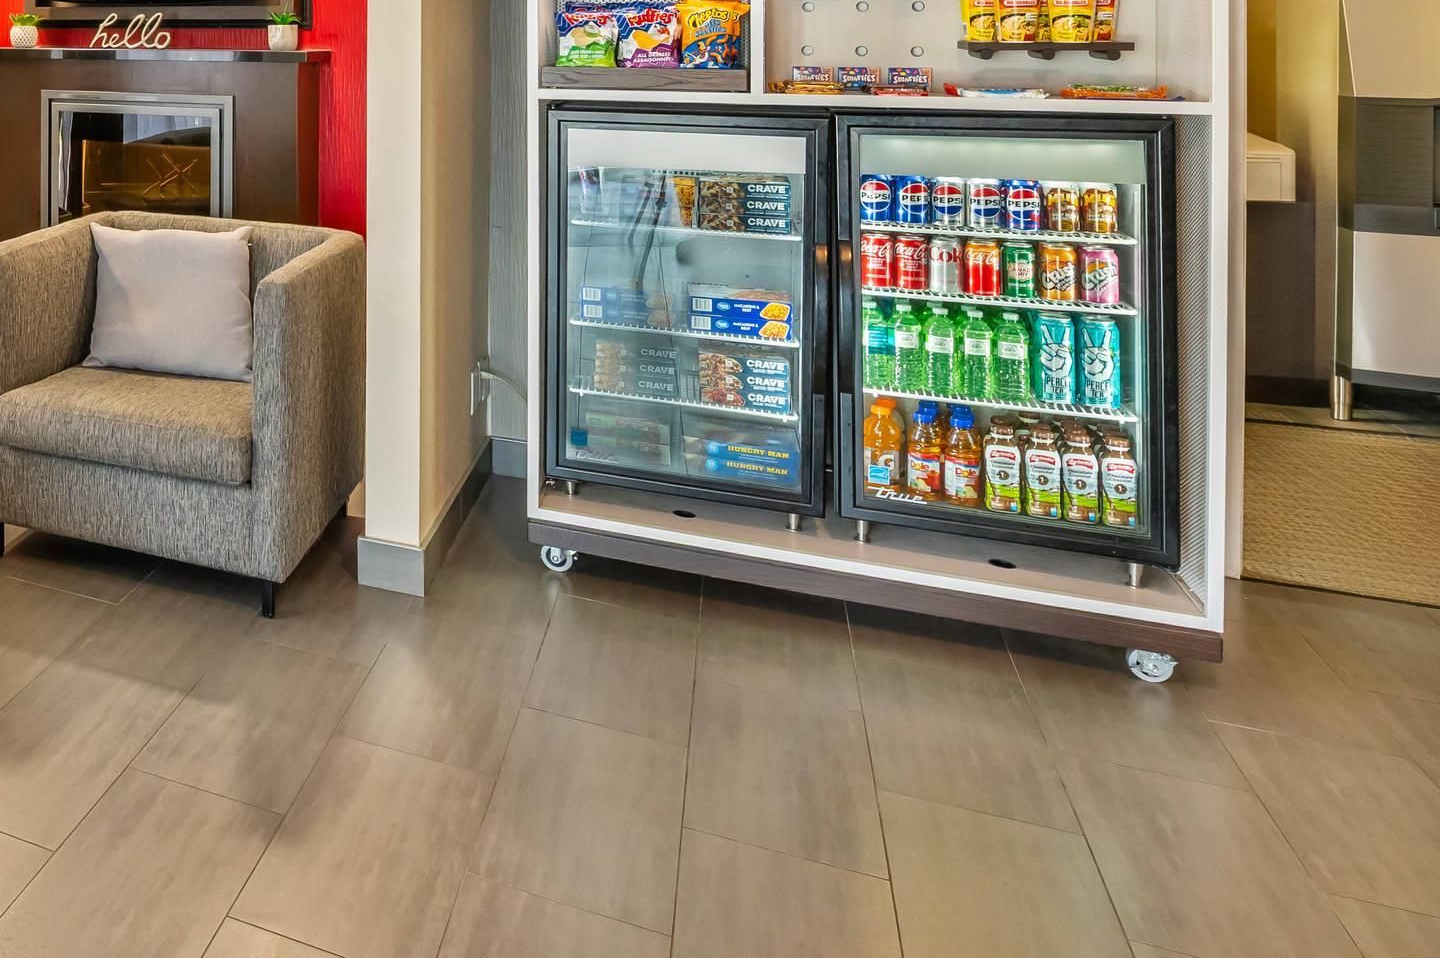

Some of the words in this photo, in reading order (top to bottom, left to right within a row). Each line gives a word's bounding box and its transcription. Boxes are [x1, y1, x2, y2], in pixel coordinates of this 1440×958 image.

[625, 8, 674, 27] Ruffles
[688, 7, 729, 29] Cheetos
[90, 12, 171, 49] hello
[747, 184, 786, 194] CRAVE
[746, 201, 785, 211] CRAVE
[747, 218, 786, 228] CRAVE
[640, 348, 677, 359] CRAVE
[639, 364, 676, 375] CRAVE
[746, 359, 785, 371] CRAVE
[638, 380, 674, 391] CRAVE
[746, 376, 785, 388] CRAVE
[747, 393, 786, 405] CRAVE
[955, 467, 977, 477] Dole
